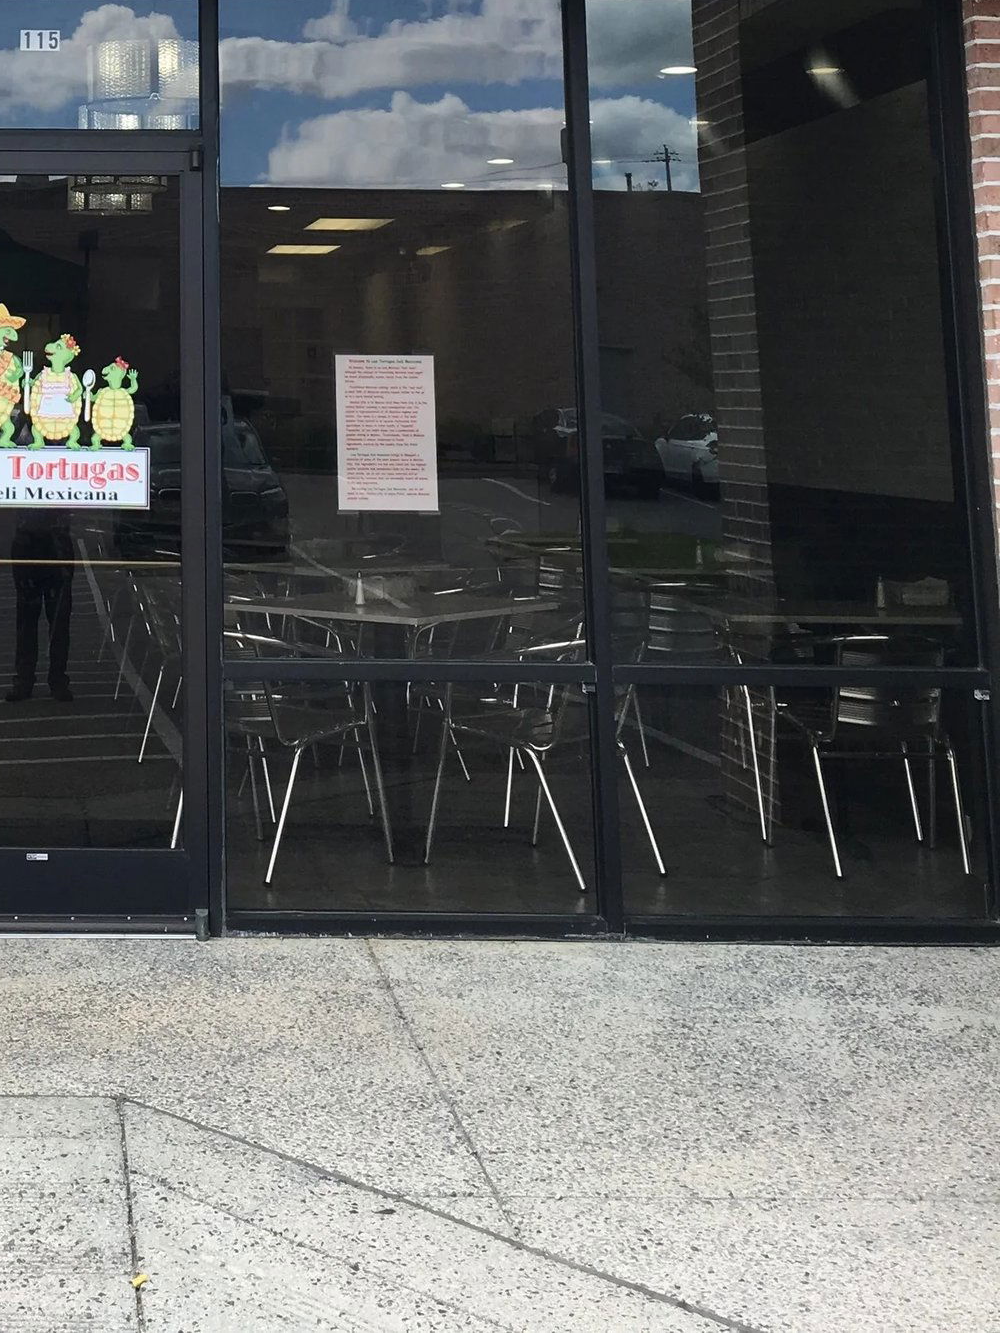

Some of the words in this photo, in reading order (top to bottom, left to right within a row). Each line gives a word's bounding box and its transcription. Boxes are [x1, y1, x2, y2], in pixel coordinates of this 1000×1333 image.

[24, 31, 59, 49] 115
[7, 455, 140, 489] Tortugas
[24, 486, 118, 501] Mexicana
